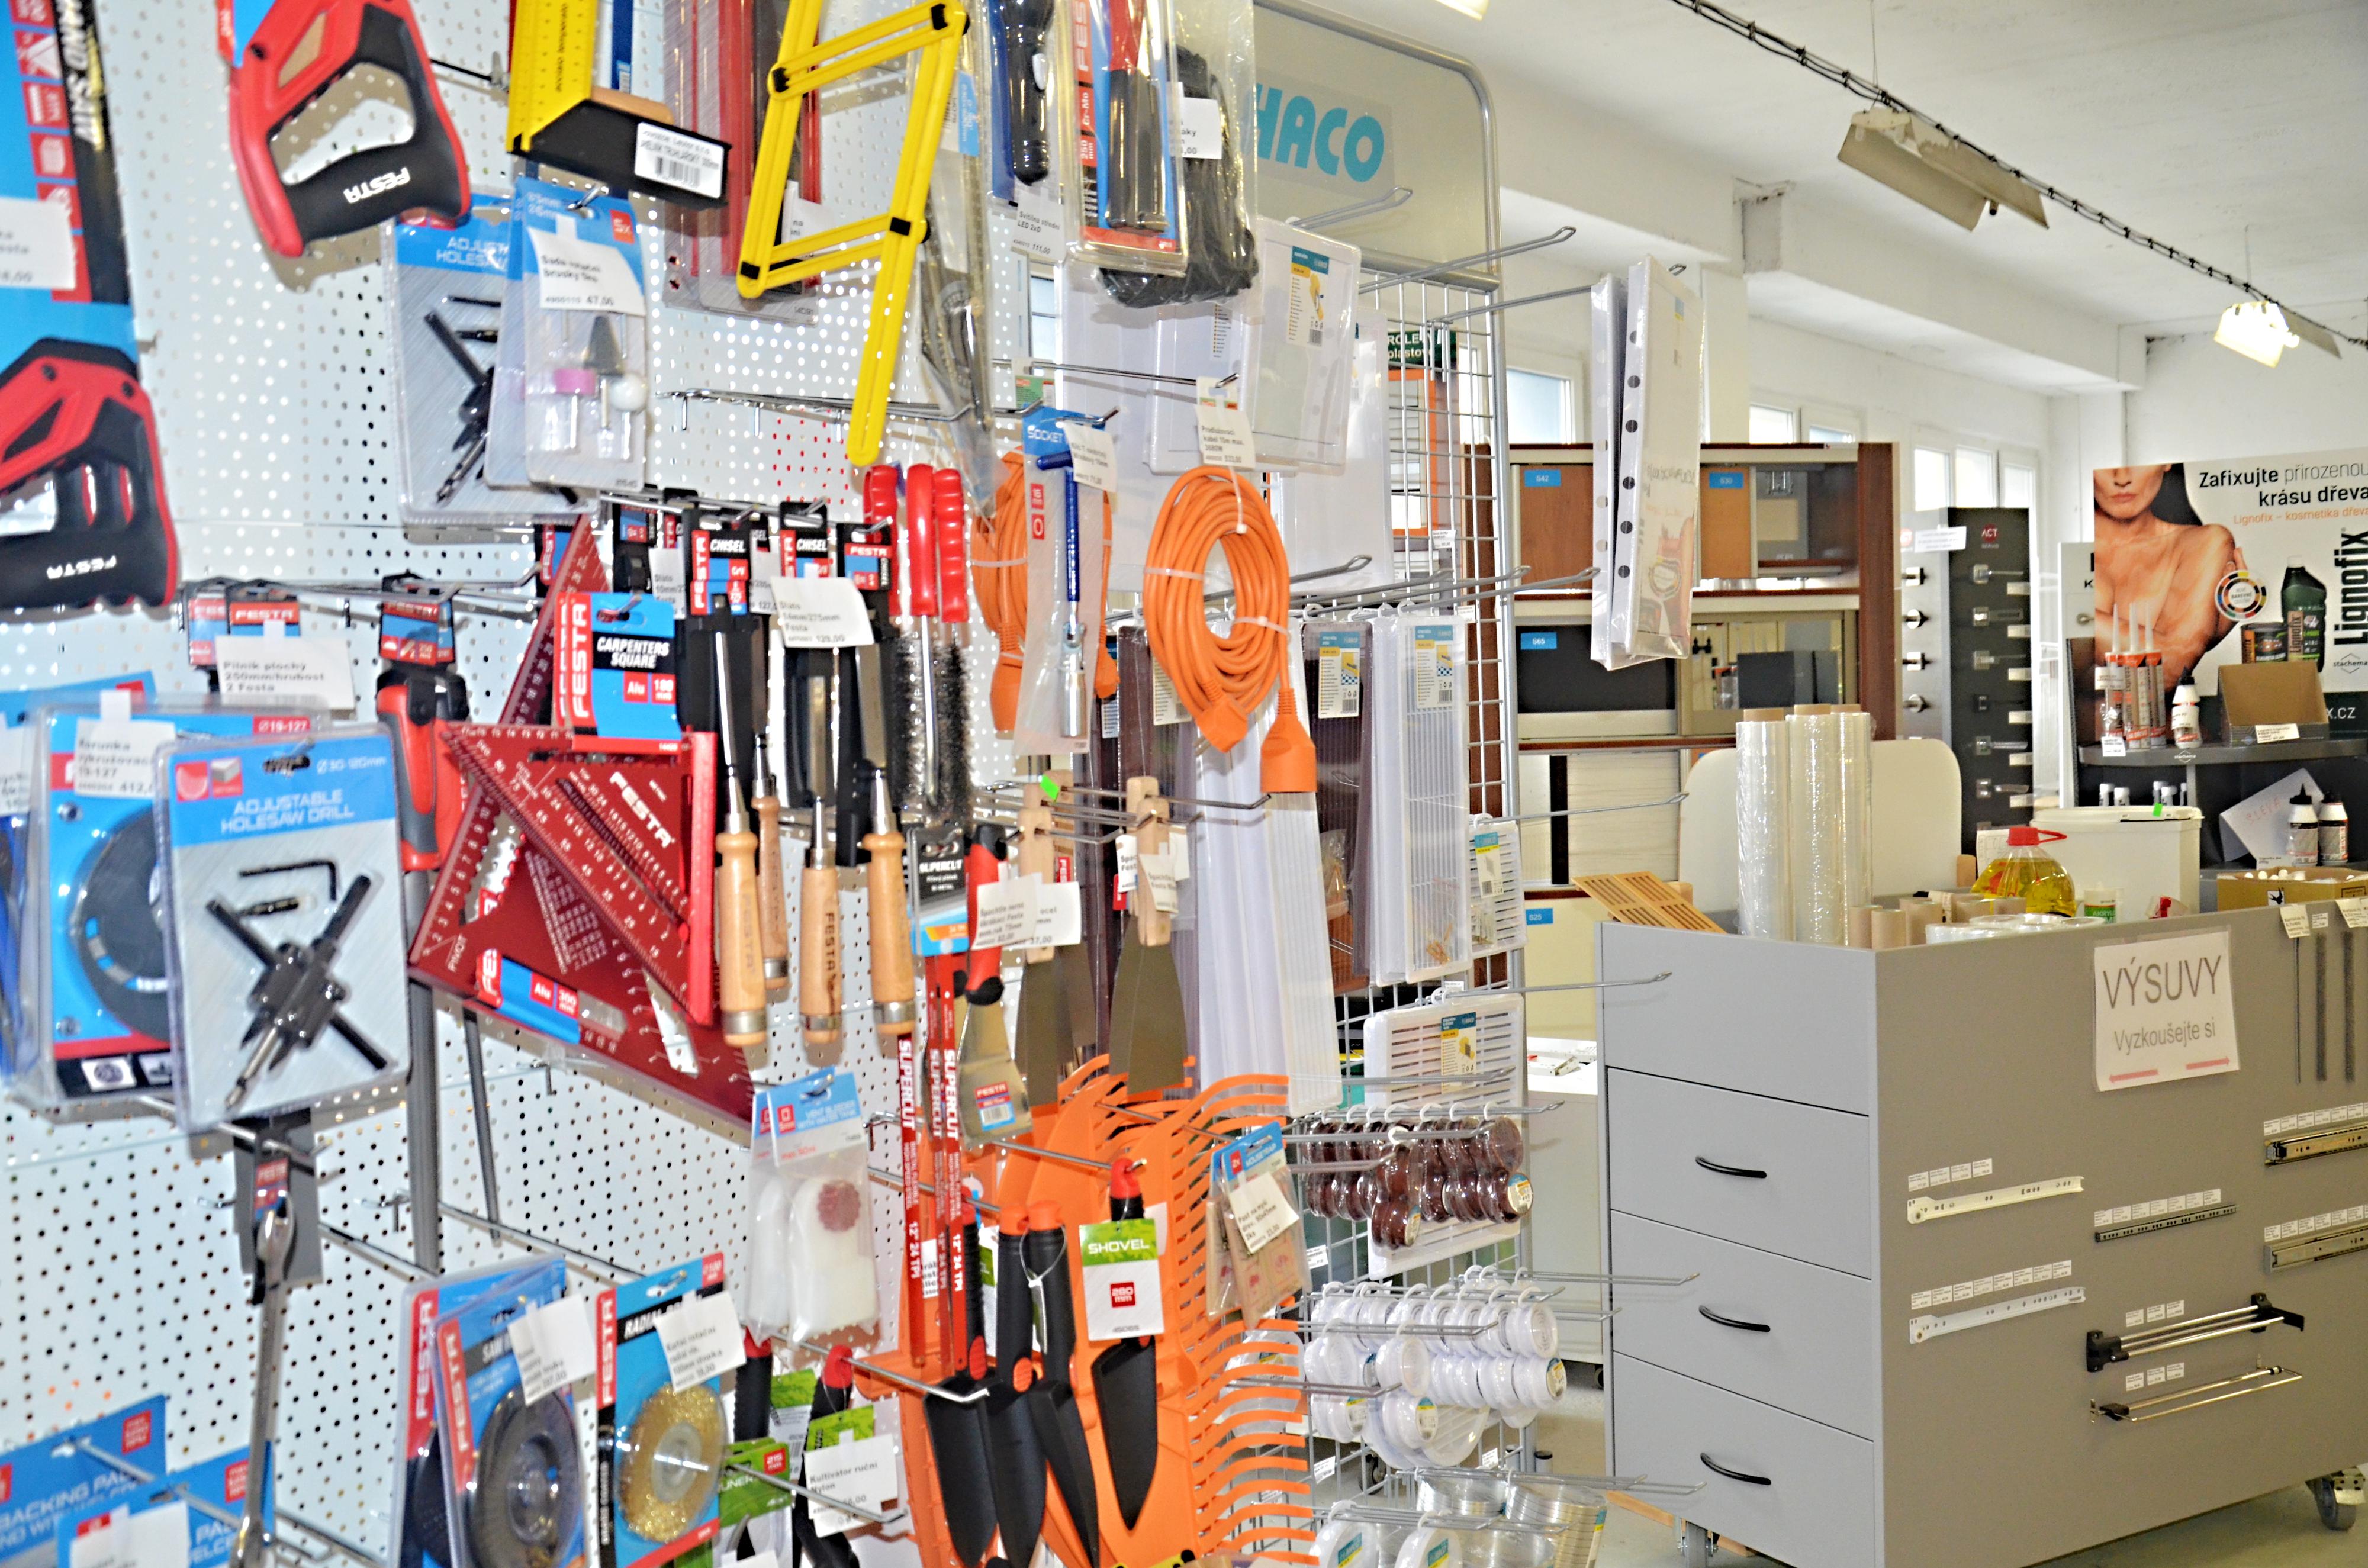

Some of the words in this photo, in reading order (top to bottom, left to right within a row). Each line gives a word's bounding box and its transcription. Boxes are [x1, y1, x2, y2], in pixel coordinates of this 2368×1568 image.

[343, 166, 411, 204] FESTA
[1017, 220, 1029, 230] LED
[1388, 332, 1431, 346] ROLE
[1027, 429, 1064, 443] SOCKET
[2199, 467, 2279, 488] Zafixujte
[2284, 461, 2368, 486] přirozenou
[2259, 489, 2311, 507] krásu
[2317, 485, 2368, 504] dřeva
[2233, 513, 2273, 525] Lignofix
[2285, 508, 2339, 522] kosmetika
[2342, 504, 2368, 519] dřeva
[710, 539, 746, 553] CHISEL
[752, 530, 768, 542] ISEL
[796, 539, 828, 552] CHISEL
[850, 546, 887, 557] FESTA
[235, 609, 295, 620] FESTA
[596, 636, 670, 656] CARPENTERS
[572, 603, 590, 719] FESTA
[610, 653, 657, 669] SQUARE
[627, 681, 645, 695] Alu
[234, 788, 343, 816] ADJUSTABLE
[609, 771, 673, 849] FESTA
[221, 809, 304, 834] HOLESAW
[308, 805, 355, 825] DRILL
[825, 912, 835, 971] FESTA
[535, 982, 551, 1000] Alu
[2102, 956, 2222, 1009] VÝSUVY
[2114, 1023, 2201, 1055] Vyzkoušejte
[2204, 1017, 2216, 1039] si
[899, 1039, 915, 1128] SUPERCUT
[929, 1048, 942, 1138] SUPERCUT
[976, 1084, 1007, 1097] FESTA
[944, 1049, 959, 1139] SUPERCUT
[910, 1239, 919, 1258] 24
[1088, 1238, 1150, 1254] SHOVEL
[911, 1260, 921, 1279] TPI
[953, 1253, 963, 1270] 24
[954, 1272, 963, 1292] TPI
[1111, 1288, 1134, 1299] 280
[623, 1308, 662, 1340] RADI
[602, 1300, 613, 1405] FESTA
[445, 1333, 470, 1451] FESTA
